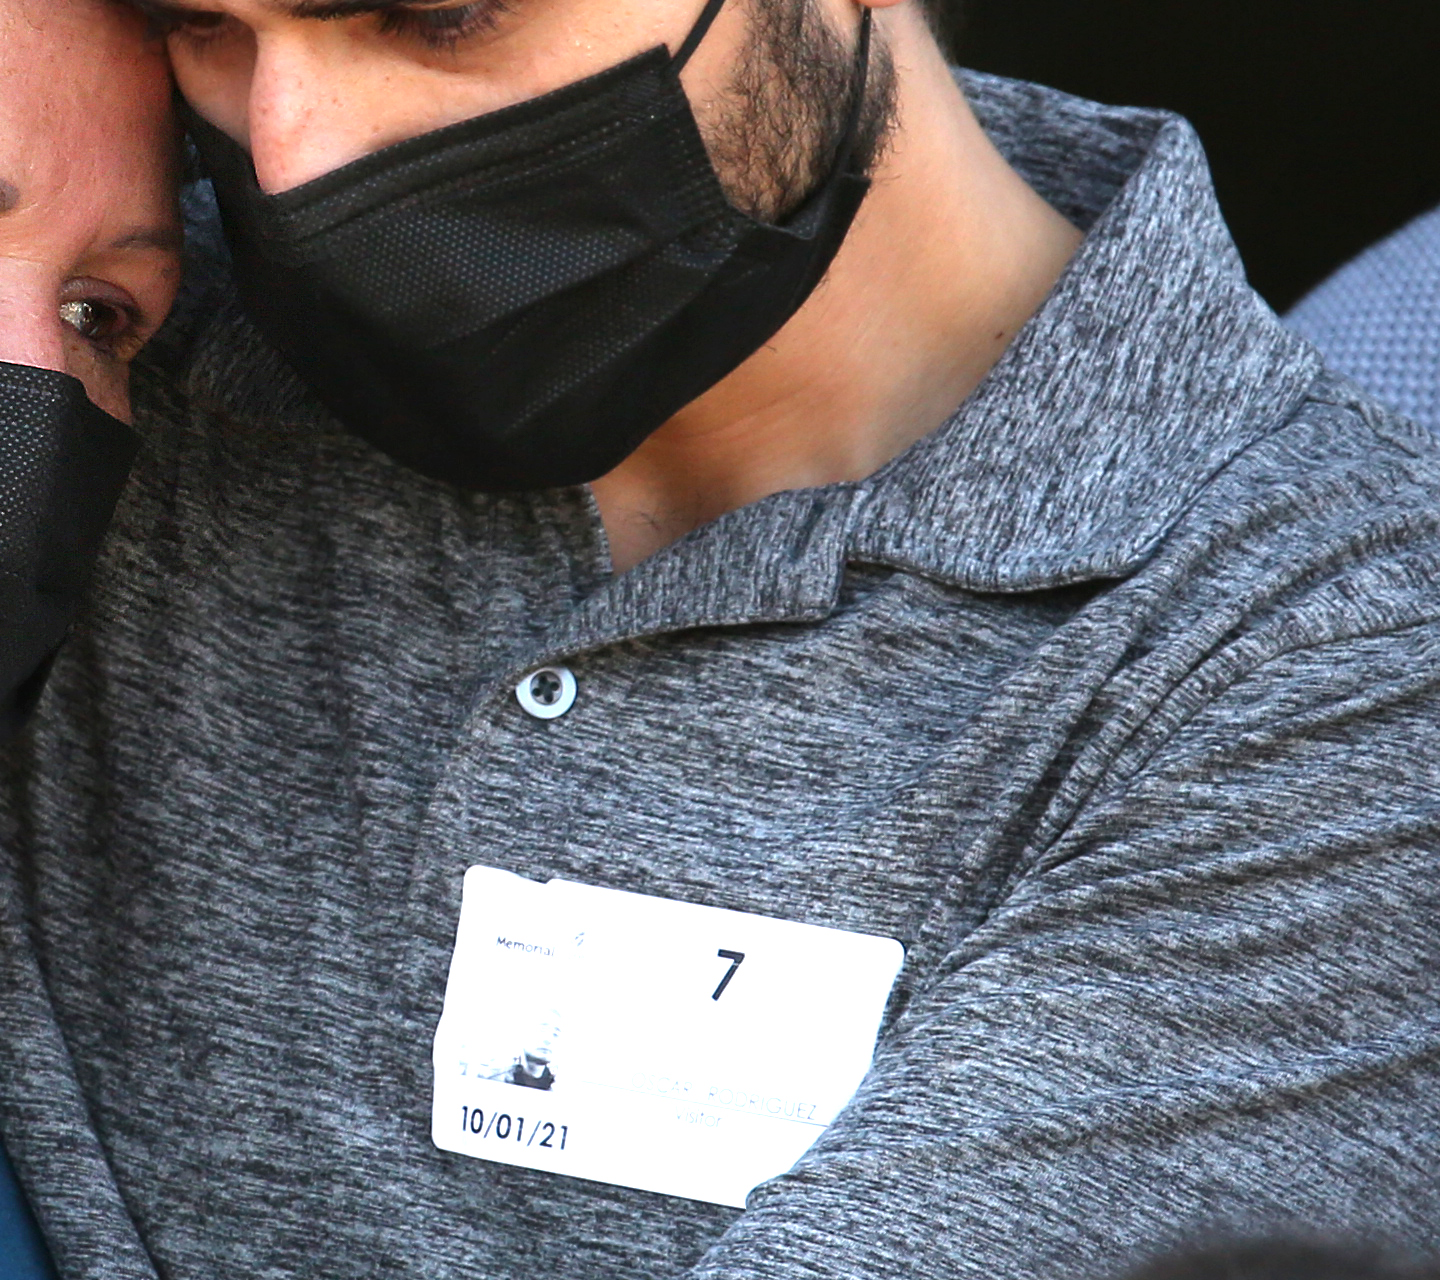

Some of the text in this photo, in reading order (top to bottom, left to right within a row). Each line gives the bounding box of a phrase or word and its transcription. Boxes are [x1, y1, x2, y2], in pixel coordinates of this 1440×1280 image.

[711, 948, 746, 1001] 7
[631, 1071, 817, 1121] OSCAR RODRIGUEZ
[460, 1105, 569, 1151] 10/01/21
